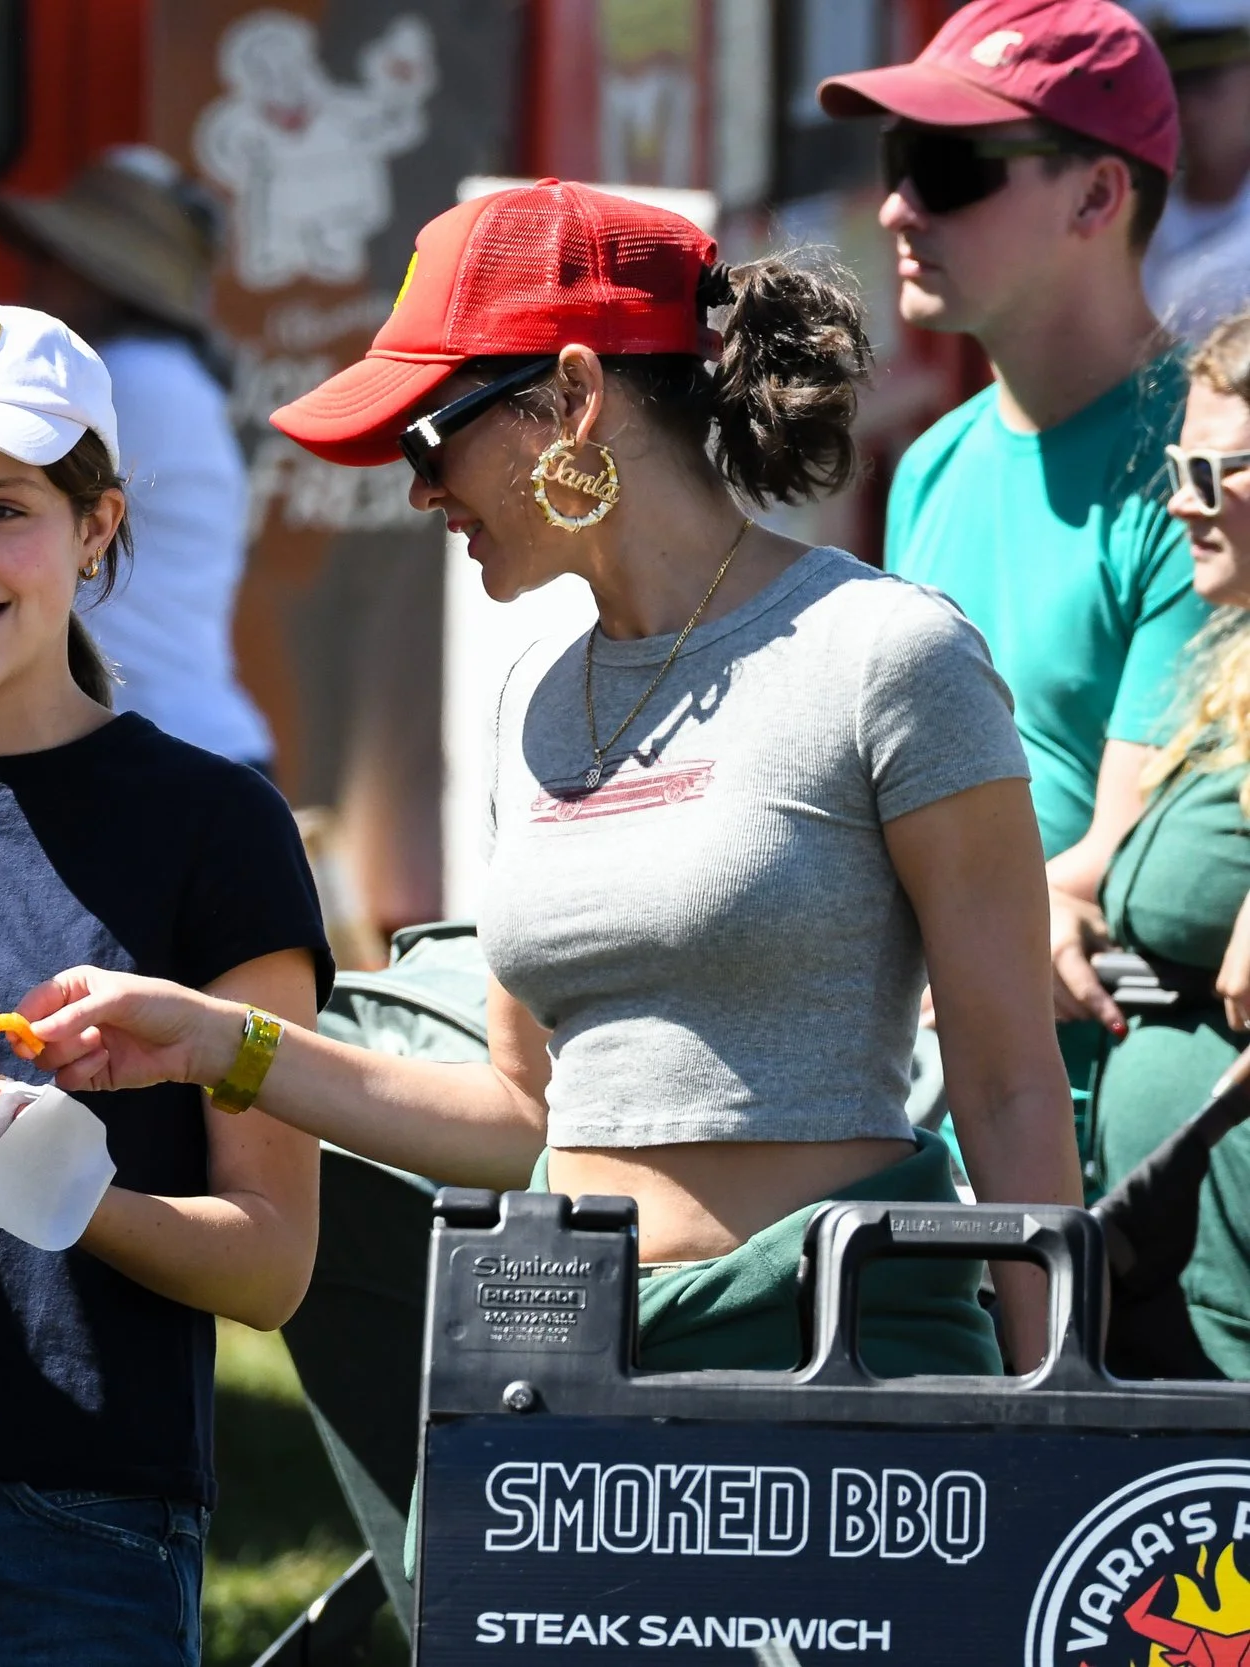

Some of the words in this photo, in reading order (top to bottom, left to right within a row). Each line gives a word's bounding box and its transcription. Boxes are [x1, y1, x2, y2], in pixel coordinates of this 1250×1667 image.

[472, 1254, 592, 1281] Signicade
[485, 1462, 810, 1557] SMOKED
[829, 1467, 986, 1564] BBQ
[1066, 1501, 1217, 1652] VARA'S
[476, 1613, 630, 1647] STEAK
[638, 1615, 891, 1651] SANDWICH
